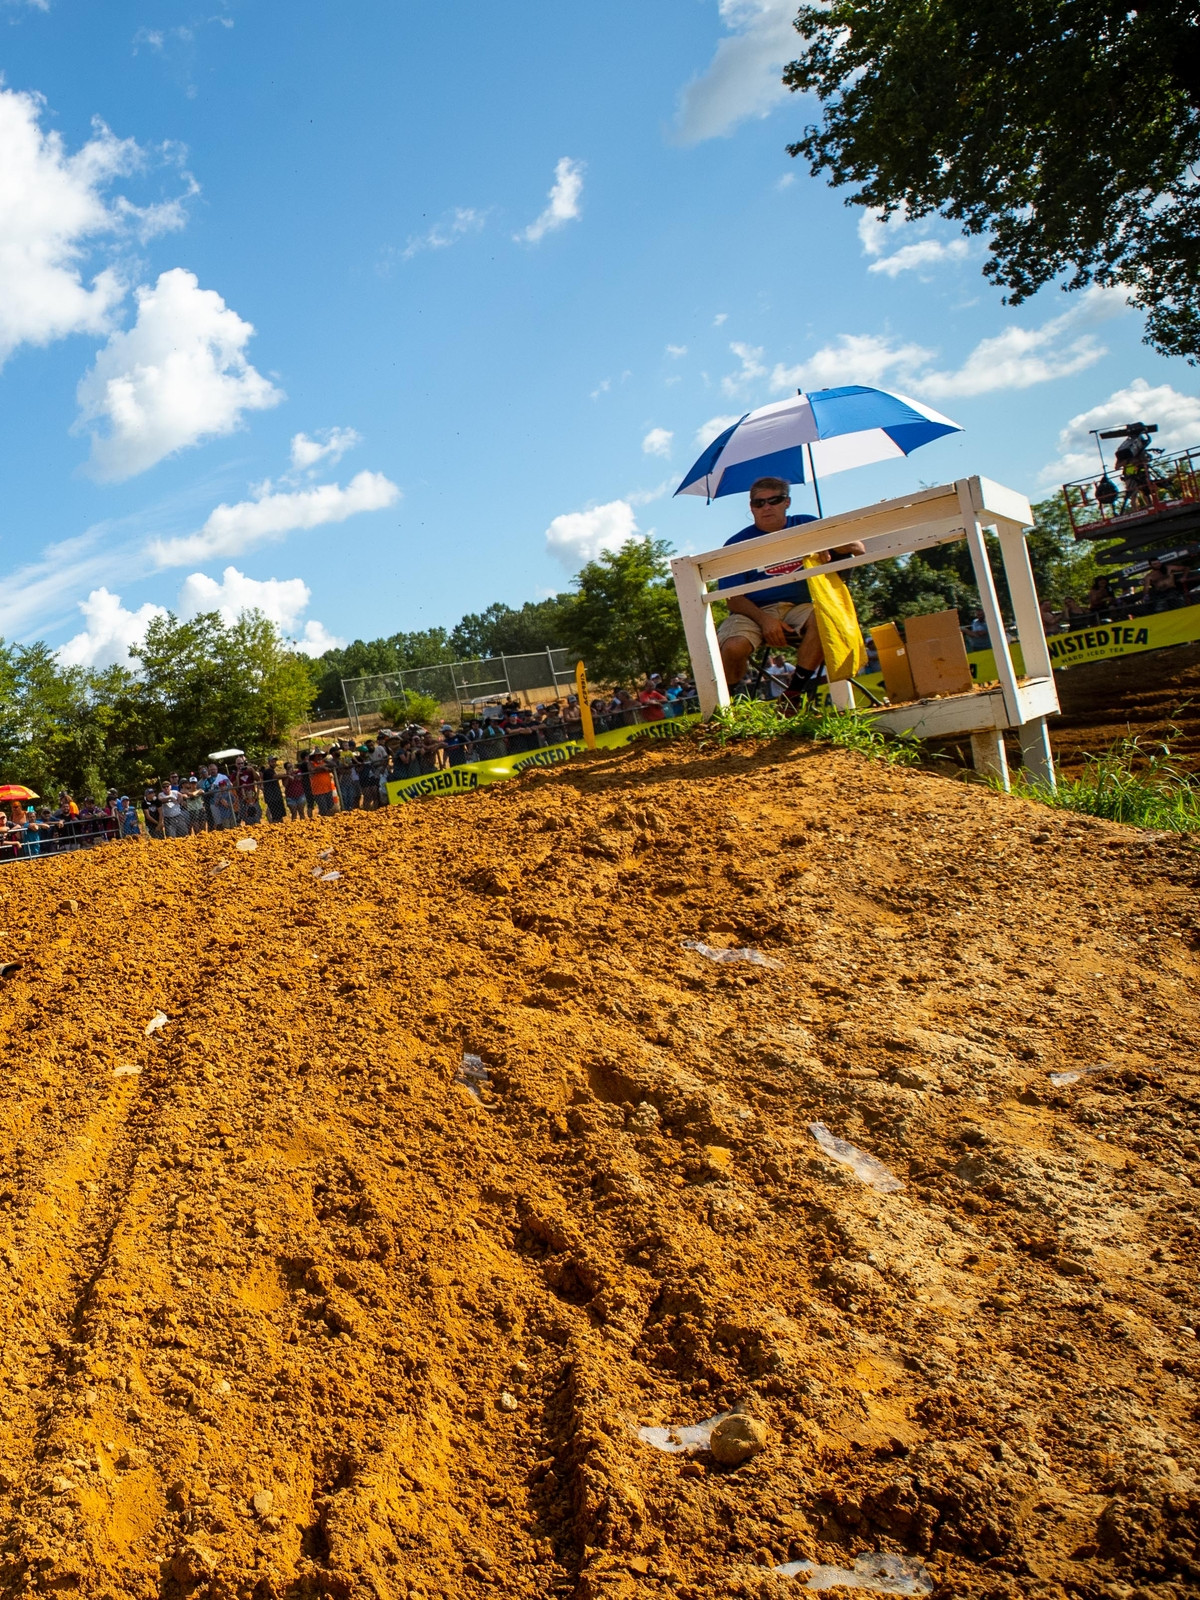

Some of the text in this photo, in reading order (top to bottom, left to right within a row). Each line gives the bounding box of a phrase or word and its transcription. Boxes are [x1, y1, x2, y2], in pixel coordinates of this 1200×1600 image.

[1048, 626, 1148, 659] WISTED TEA
[1062, 646, 1125, 664] HARD ICED TEA
[397, 770, 478, 802] TWISTED TEA
